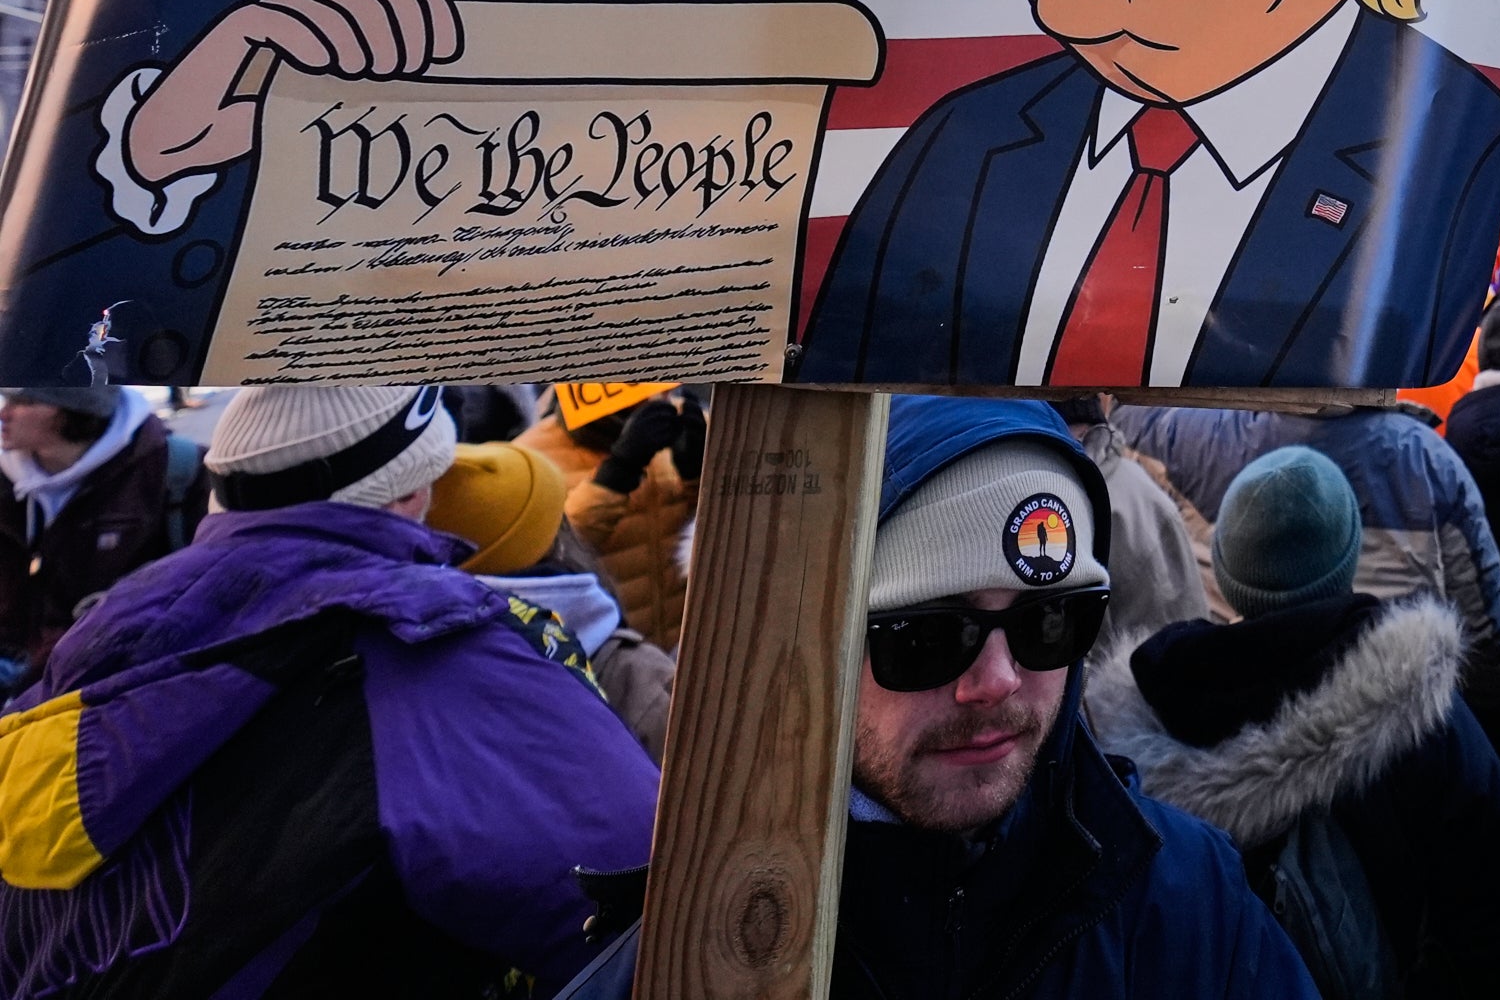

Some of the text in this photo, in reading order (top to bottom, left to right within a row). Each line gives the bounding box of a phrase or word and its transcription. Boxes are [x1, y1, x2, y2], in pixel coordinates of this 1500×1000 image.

[300, 101, 797, 225] We the People
[1010, 499, 1071, 533] GRAND CANYON
[1016, 552, 1073, 581] RIM TO RIM
